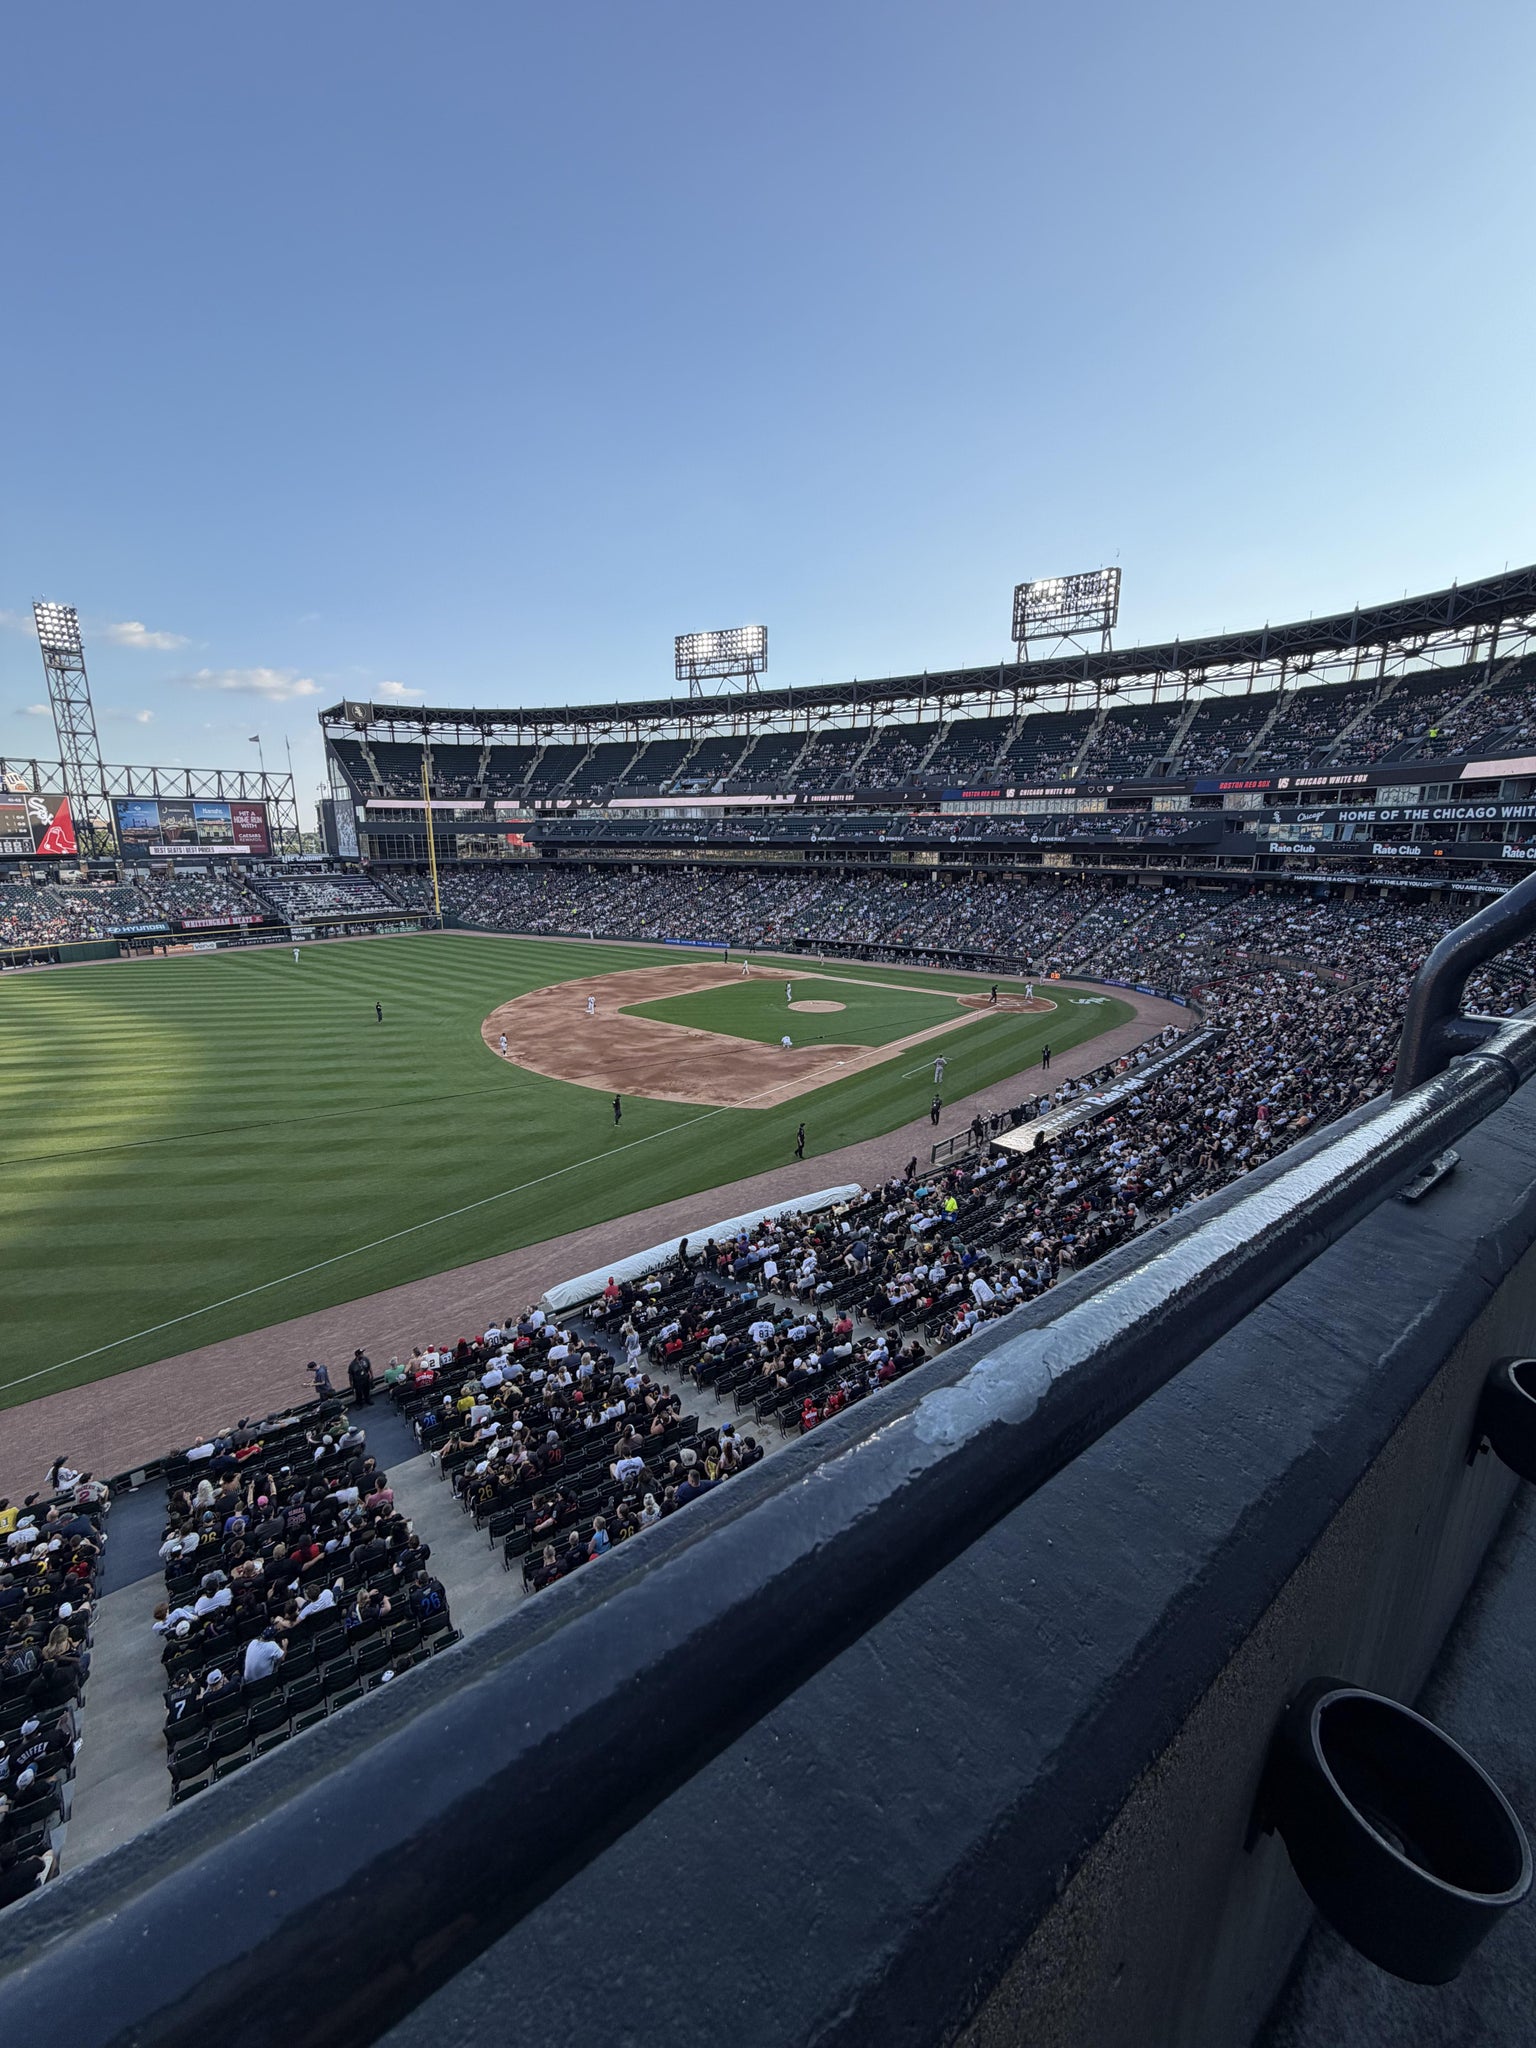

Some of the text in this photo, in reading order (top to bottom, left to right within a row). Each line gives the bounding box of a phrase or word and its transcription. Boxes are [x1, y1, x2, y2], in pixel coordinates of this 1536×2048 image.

[1278, 778, 1290, 789] VS
[1295, 777, 1327, 786] CHICAGO
[1328, 775, 1353, 784] WHITE
[1353, 774, 1368, 783] SOX
[1006, 789, 1015, 797] VS
[1297, 810, 1326, 822] Chicago
[1339, 806, 1536, 821] HOME OF THE CHICAGO WHIT
[1270, 843, 1315, 853] Rate Club
[1372, 844, 1421, 855] Rate Club
[1502, 845, 1525, 858] Rate
[1083, 1091, 1124, 1106] Rate
[1111, 1078, 1145, 1093] Field
[429, 1359, 435, 1367] 2
[79, 1491, 90, 1503] 2
[478, 1484, 493, 1502] 26
[619, 1525, 634, 1540] 26
[421, 1593, 440, 1616] 26
[175, 1699, 186, 1719] 7
